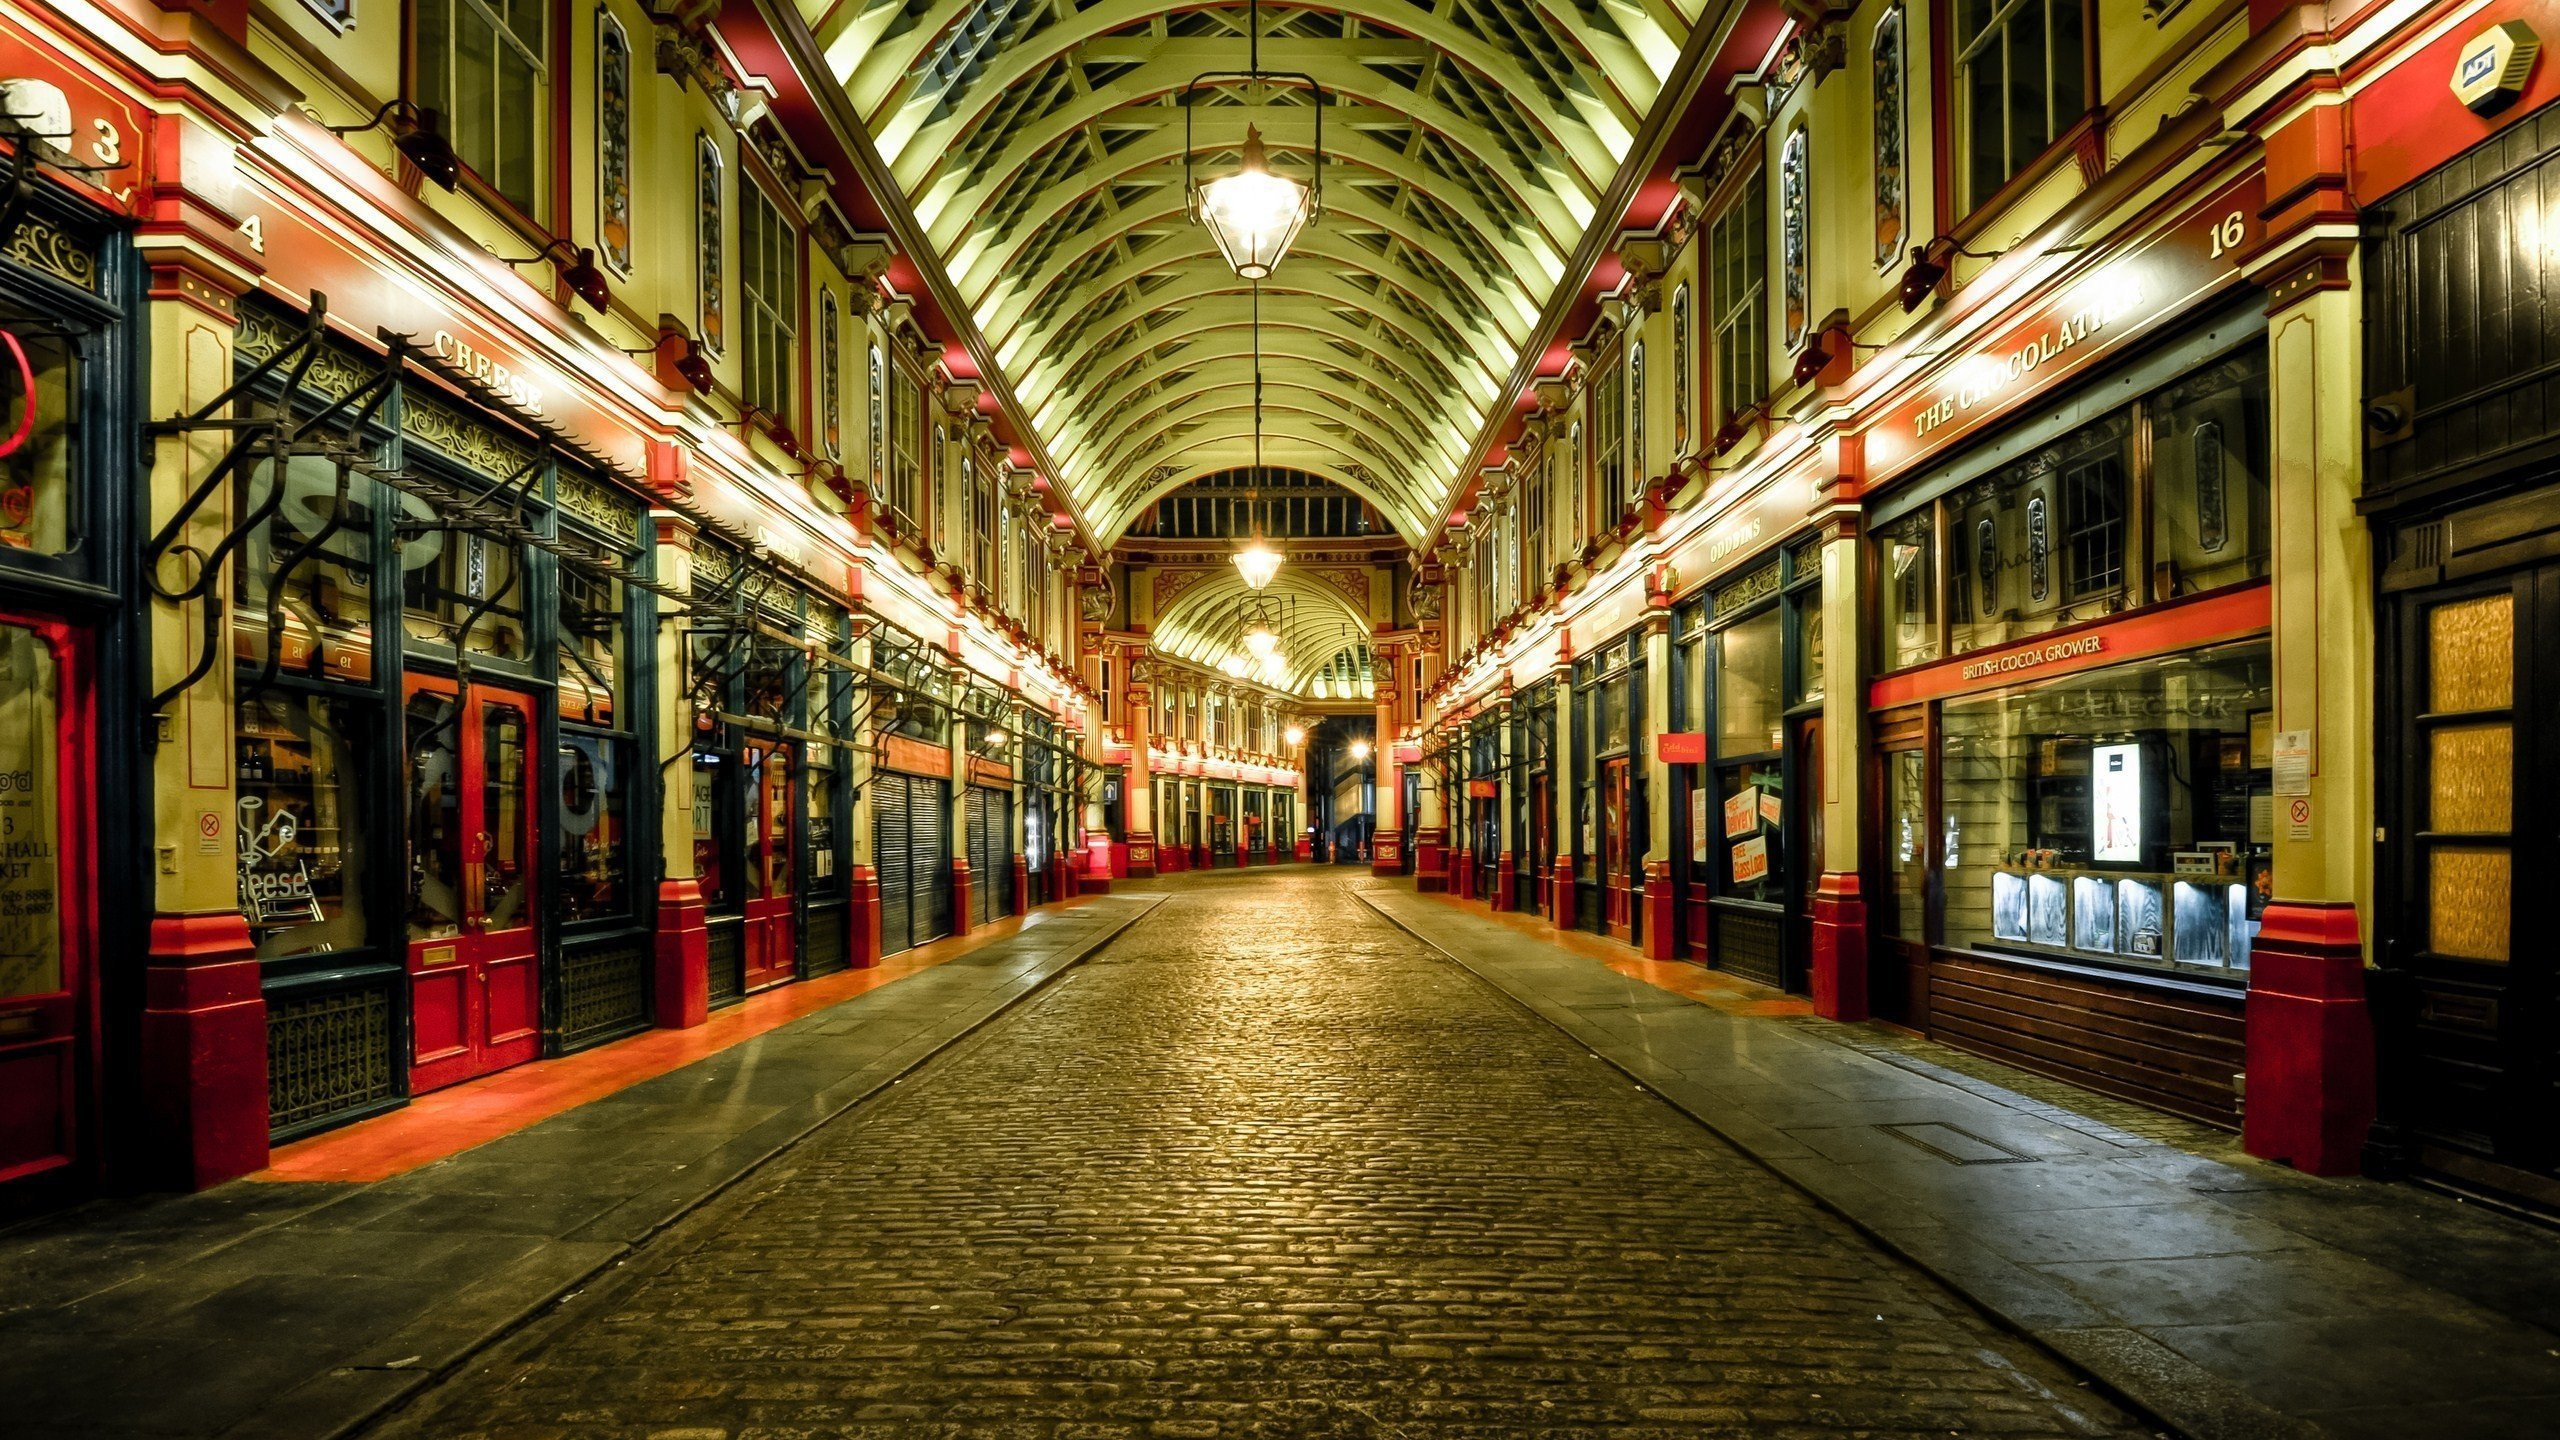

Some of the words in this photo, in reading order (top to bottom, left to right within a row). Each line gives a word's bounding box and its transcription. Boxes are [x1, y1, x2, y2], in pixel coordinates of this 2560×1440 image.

[2464, 49, 2494, 83] ADT
[92, 118, 119, 164] 3
[239, 214, 263, 253] 4
[2210, 211, 2244, 259] 16
[1914, 394, 1954, 437] THE
[1963, 660, 1998, 680] BRITISH
[2001, 649, 2042, 672] COCOA
[2046, 636, 2100, 662] GROWER
[3, 816, 15, 835] 3
[1750, 853, 1765, 877] Loan
